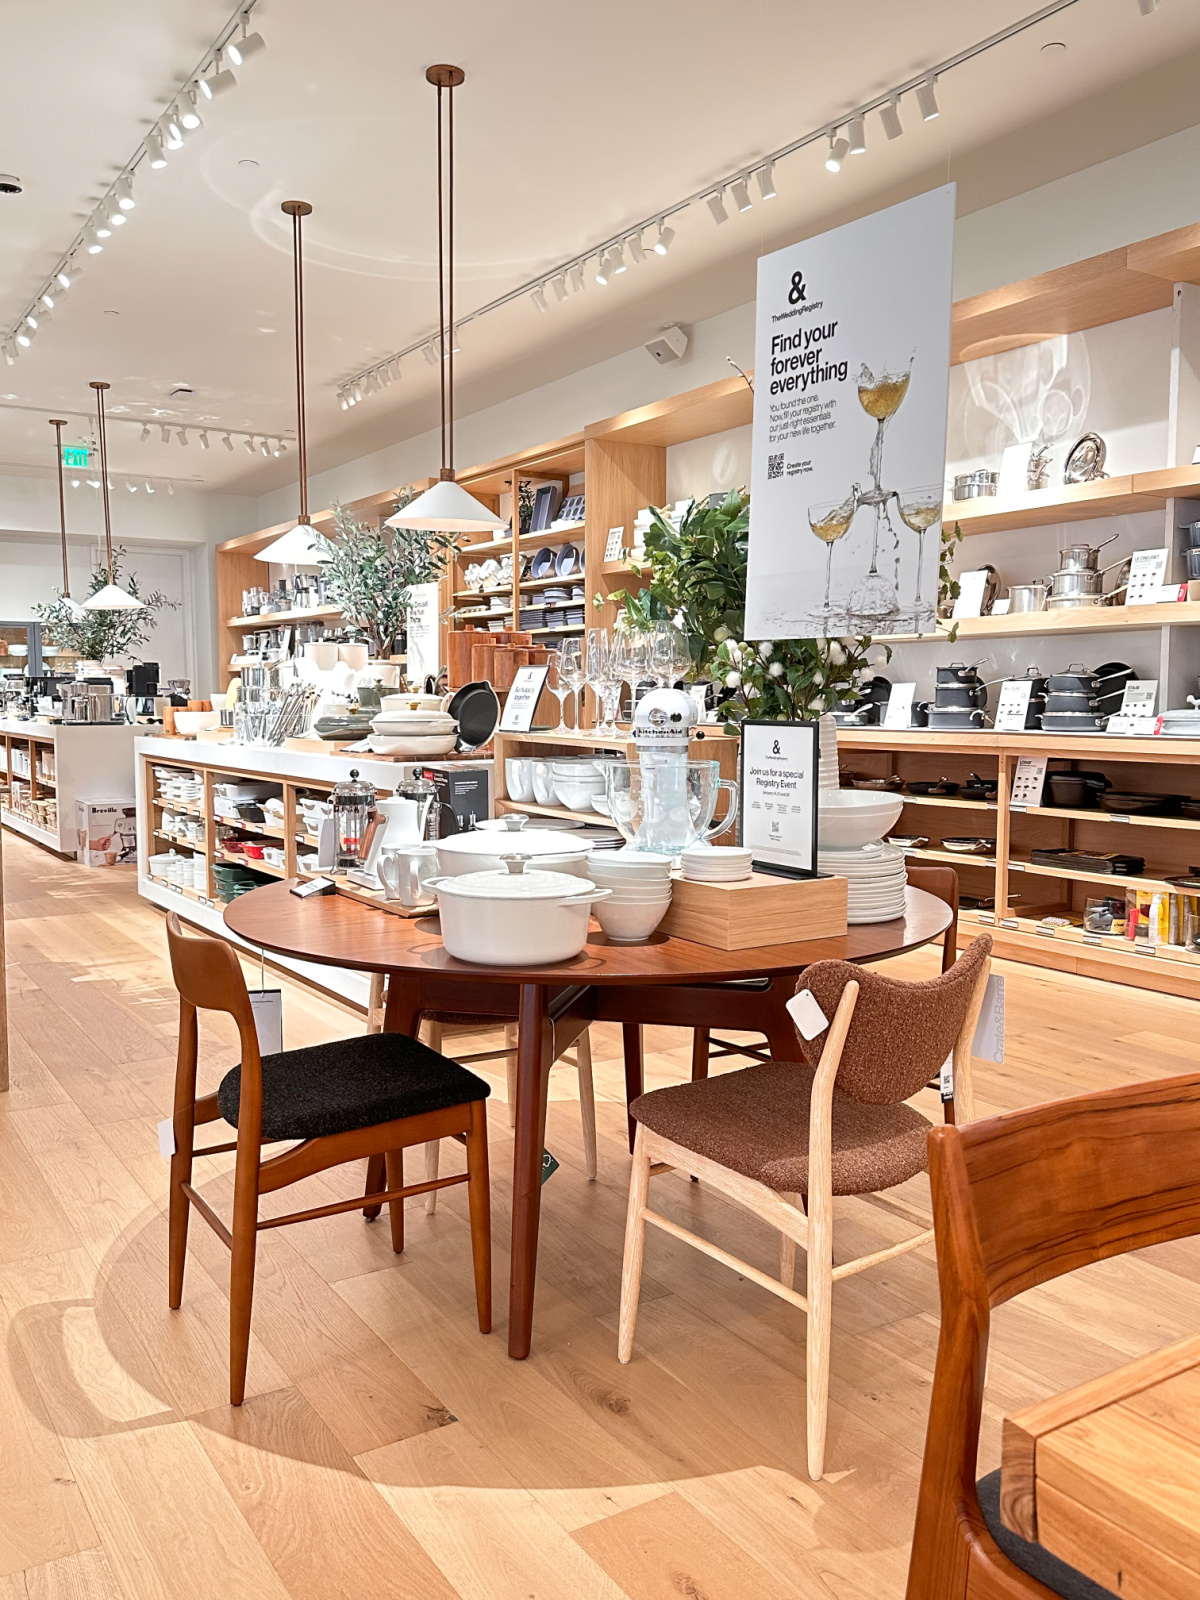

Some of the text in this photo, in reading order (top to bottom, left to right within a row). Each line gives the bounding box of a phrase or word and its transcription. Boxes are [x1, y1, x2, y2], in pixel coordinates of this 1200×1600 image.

[788, 270, 807, 305] &
[771, 301, 824, 323] TheWeddingRegistry
[771, 320, 838, 356] Find your
[770, 347, 823, 377] forever
[769, 360, 848, 396] everything
[769, 394, 819, 413] You found the one.
[789, 408, 802, 420] your
[802, 403, 824, 416] registry
[824, 398, 837, 409] with
[769, 410, 832, 433] our just-right essentials
[769, 434, 777, 443] for
[777, 432, 790, 443] your
[789, 430, 801, 438] new
[802, 426, 811, 435] life
[65, 447, 88, 467] EXIT
[786, 462, 801, 470] Create
[786, 468, 803, 477] registry
[772, 739, 781, 755] &
[749, 766, 762, 775] Join
[770, 768, 778, 777] for
[783, 770, 804, 779] special
[756, 777, 797, 789] Registry Event
[993, 976, 1004, 1063] Crate&Barre
